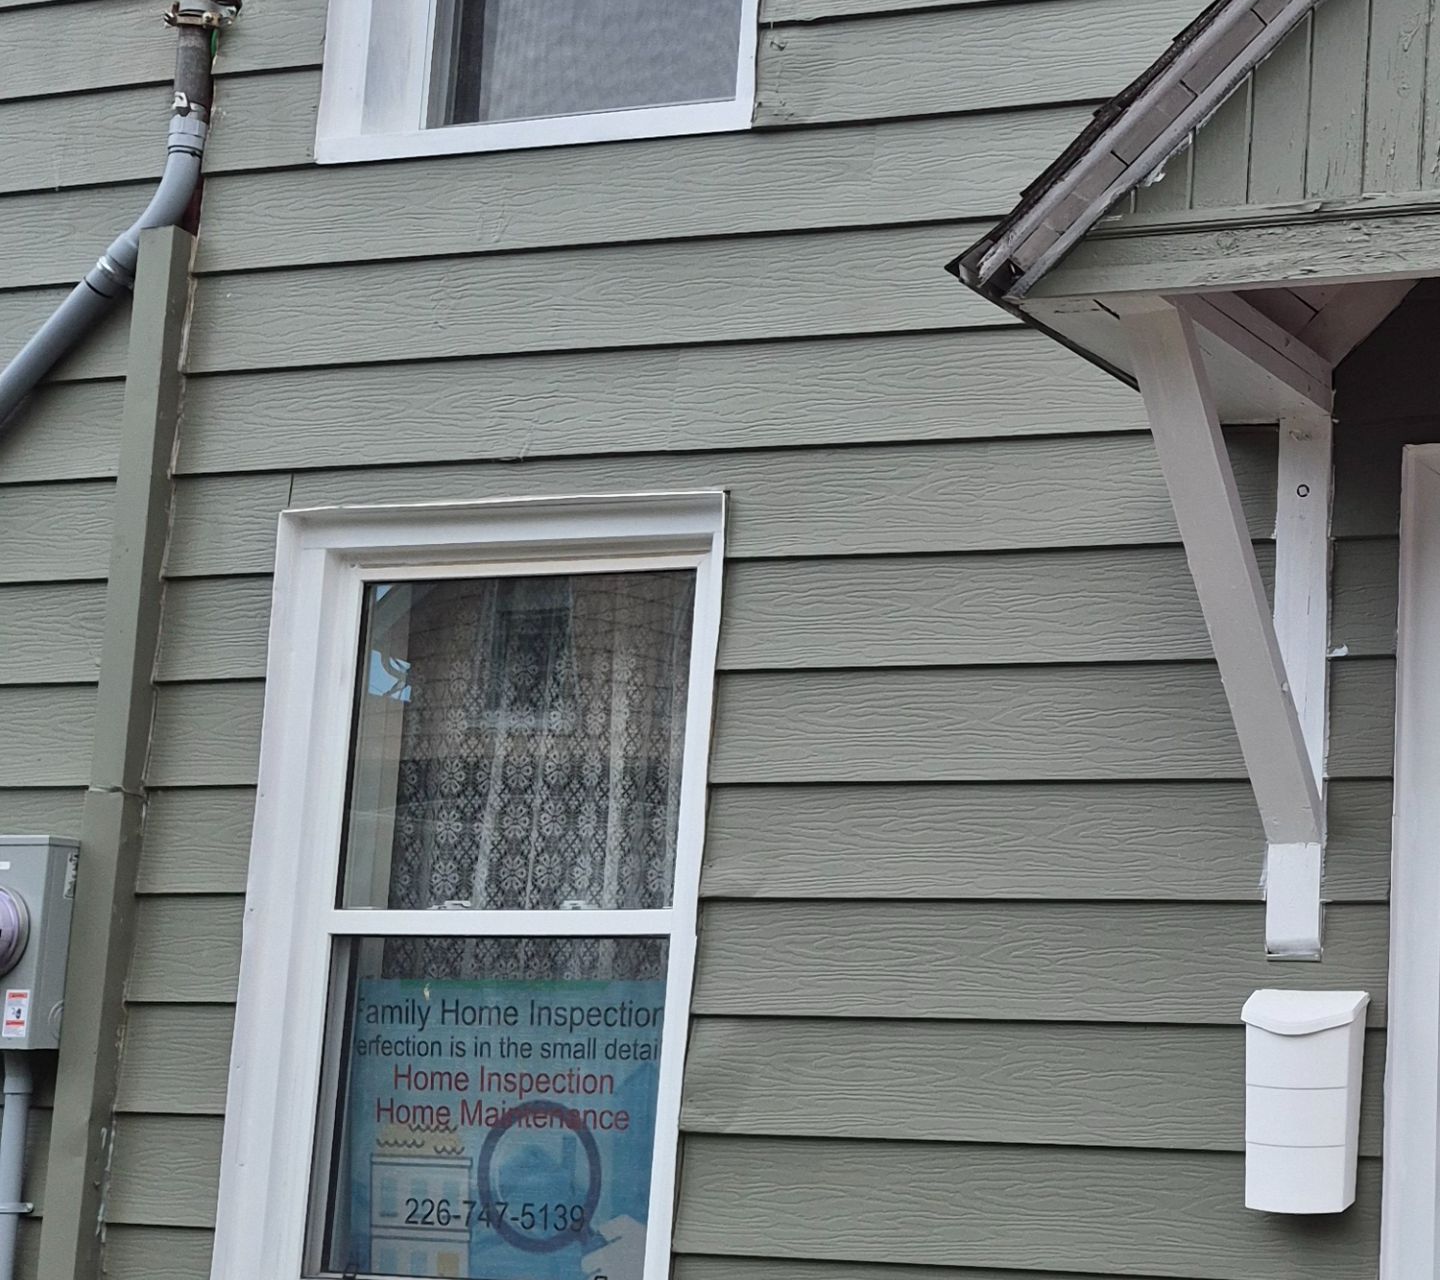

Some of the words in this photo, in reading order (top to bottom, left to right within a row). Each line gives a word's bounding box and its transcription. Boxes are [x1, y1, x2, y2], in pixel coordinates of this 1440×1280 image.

[441, 999, 519, 1026] Home
[356, 1034, 442, 1057] erfection
[450, 1036, 466, 1058] is
[474, 1036, 491, 1058] in
[500, 1036, 532, 1059] the
[540, 1037, 597, 1060] small
[604, 1038, 659, 1061] detai
[394, 1064, 469, 1091] Home
[480, 1065, 614, 1100] Inspection
[376, 1097, 451, 1125] Home
[460, 1098, 630, 1131] Maintenance
[404, 1198, 585, 1233] 226-747-5139
